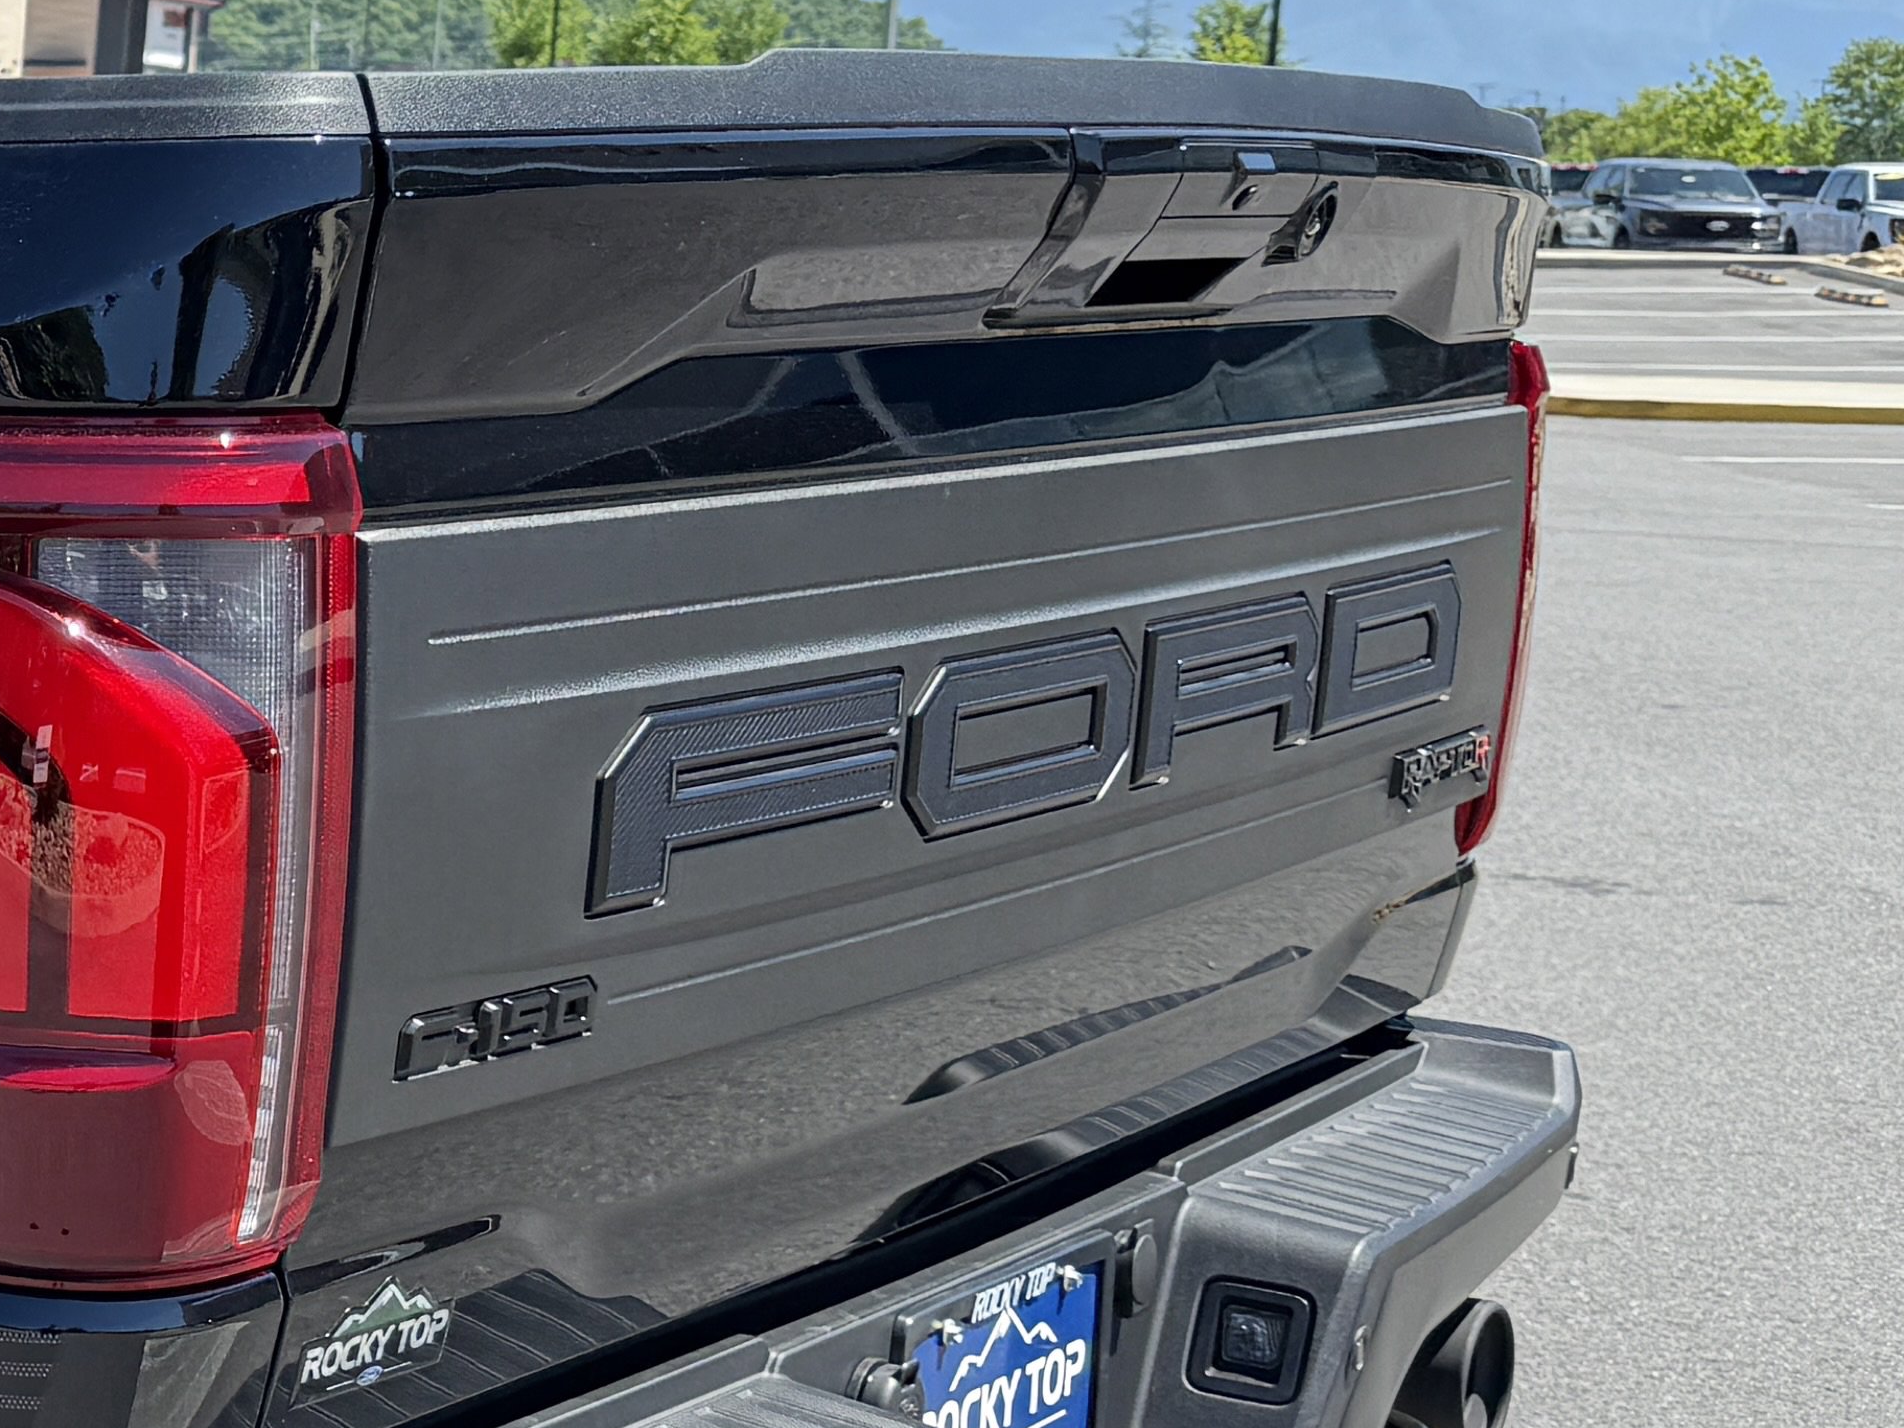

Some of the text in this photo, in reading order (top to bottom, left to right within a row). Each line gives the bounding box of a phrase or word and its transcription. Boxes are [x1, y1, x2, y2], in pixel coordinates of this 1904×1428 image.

[585, 558, 1464, 920] FORD
[1388, 723, 1492, 812] RAPTOR
[391, 973, 599, 1084] F-150
[971, 1262, 1057, 1325] ROCKY TOP
[300, 1324, 396, 1384] ROCKY
[397, 1308, 450, 1354] TOP
[1025, 1338, 1086, 1414] TOP
